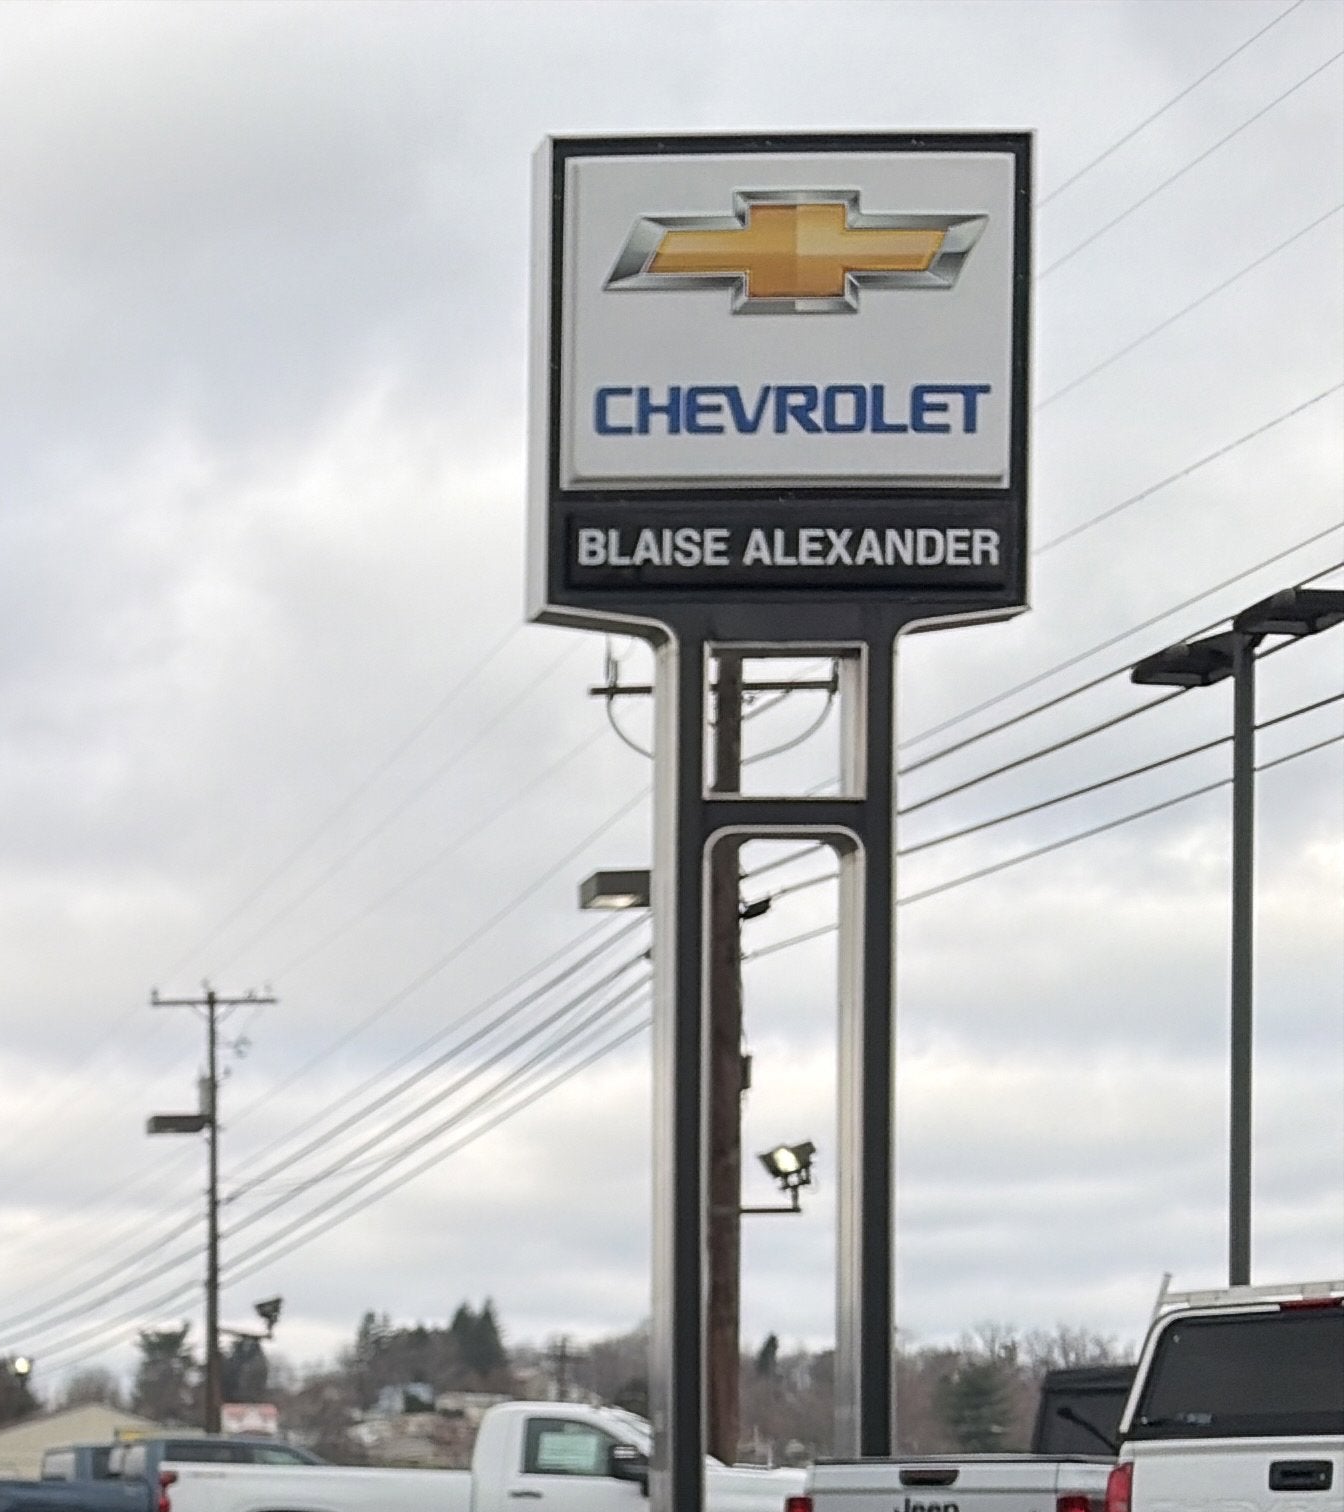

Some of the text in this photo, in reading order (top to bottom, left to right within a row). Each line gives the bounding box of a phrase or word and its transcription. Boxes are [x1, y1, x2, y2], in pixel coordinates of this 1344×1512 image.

[594, 384, 991, 434] CHEVROLET
[577, 527, 1000, 566] BLAISE ALEXANDER
